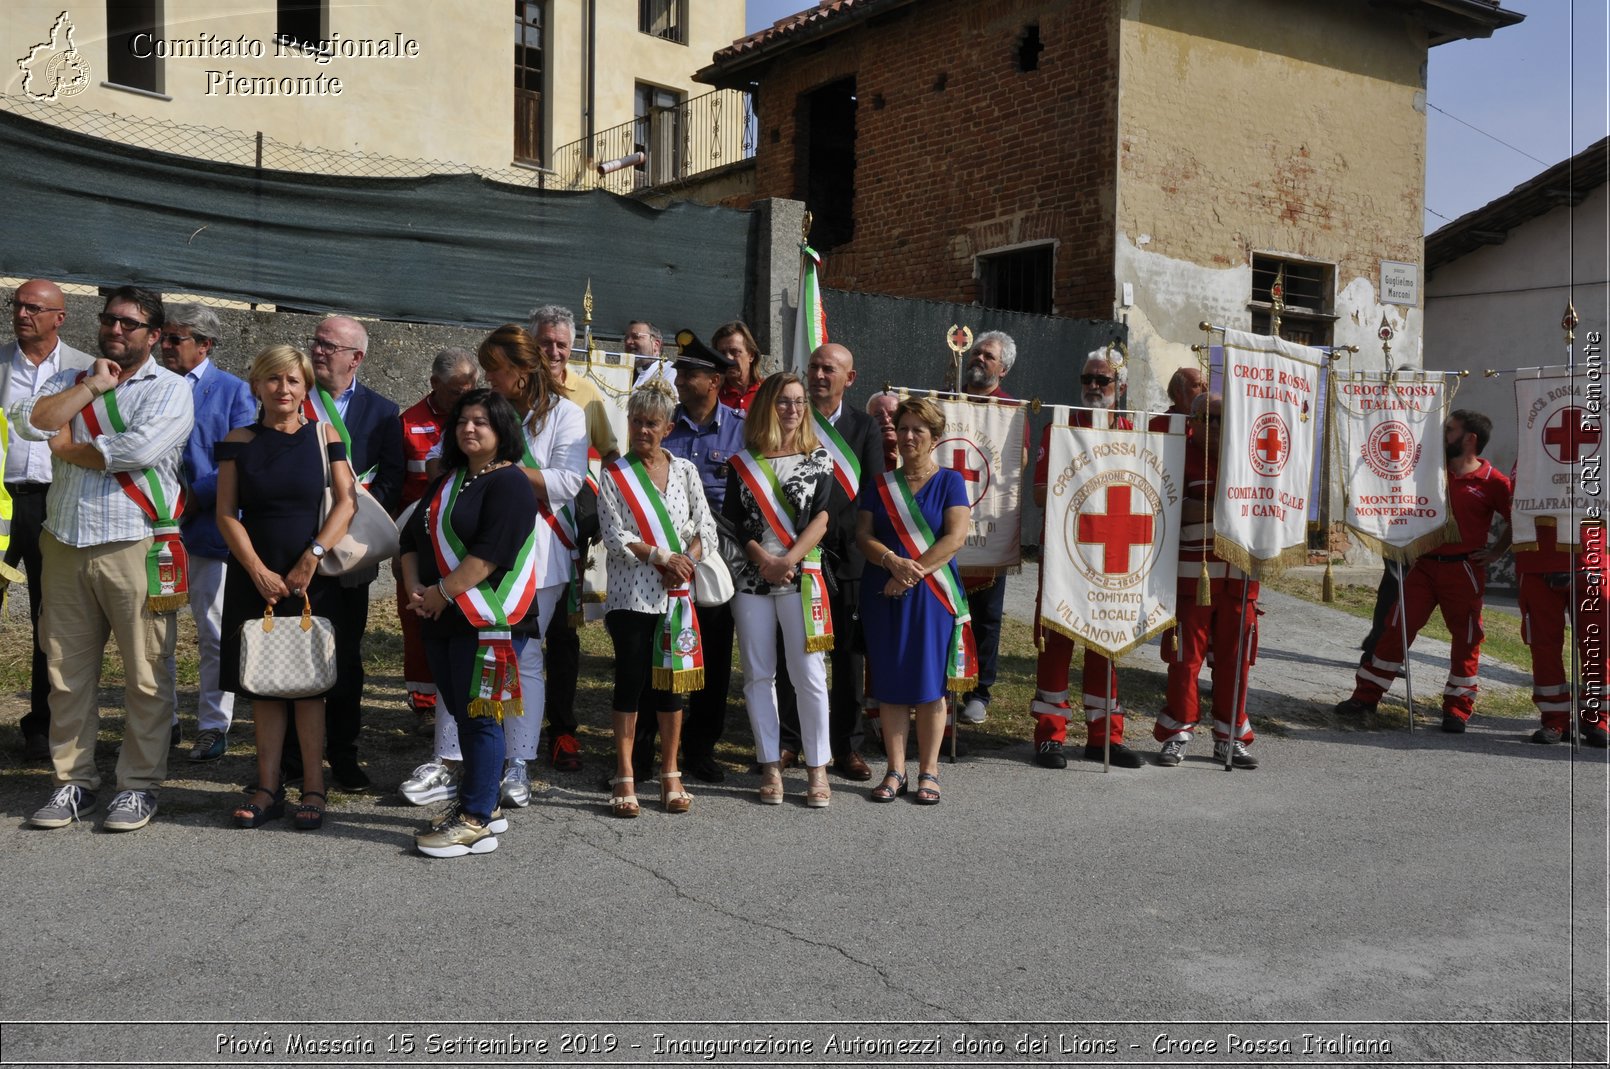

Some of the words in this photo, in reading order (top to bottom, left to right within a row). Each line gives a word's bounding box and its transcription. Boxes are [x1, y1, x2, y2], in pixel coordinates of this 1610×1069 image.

[1384, 274, 1414, 287] Guglielmo
[1388, 288, 1411, 299] Marconi
[1233, 364, 1275, 381] CROCE
[1278, 370, 1311, 393] ROSSA
[1246, 383, 1299, 407] ITALIANA
[1343, 384, 1390, 396] CROCE
[1396, 386, 1436, 397] ROSSA
[1360, 399, 1421, 411] ITALIANA
[1526, 397, 1548, 430] CROCE
[1547, 385, 1581, 402] ROSSA
[944, 422, 969, 434] OSSA
[974, 429, 1002, 471] ITALIANA
[1361, 443, 1389, 480] VOLONTARI
[1053, 450, 1091, 497] CROCE
[1092, 442, 1136, 459] ROSSA
[1139, 447, 1178, 506] ITALIANA
[1128, 474, 1137, 482] DI
[1227, 486, 1275, 500] COMITATO
[1360, 494, 1429, 506] MONTIGLIO
[1515, 496, 1590, 510] VILLAFRANCA
[1241, 504, 1249, 517] DI
[987, 521, 996, 533] DI
[1087, 591, 1143, 604] COMITATO
[1091, 608, 1137, 621] LOCALE
[1056, 599, 1128, 644] VILLANOVA
